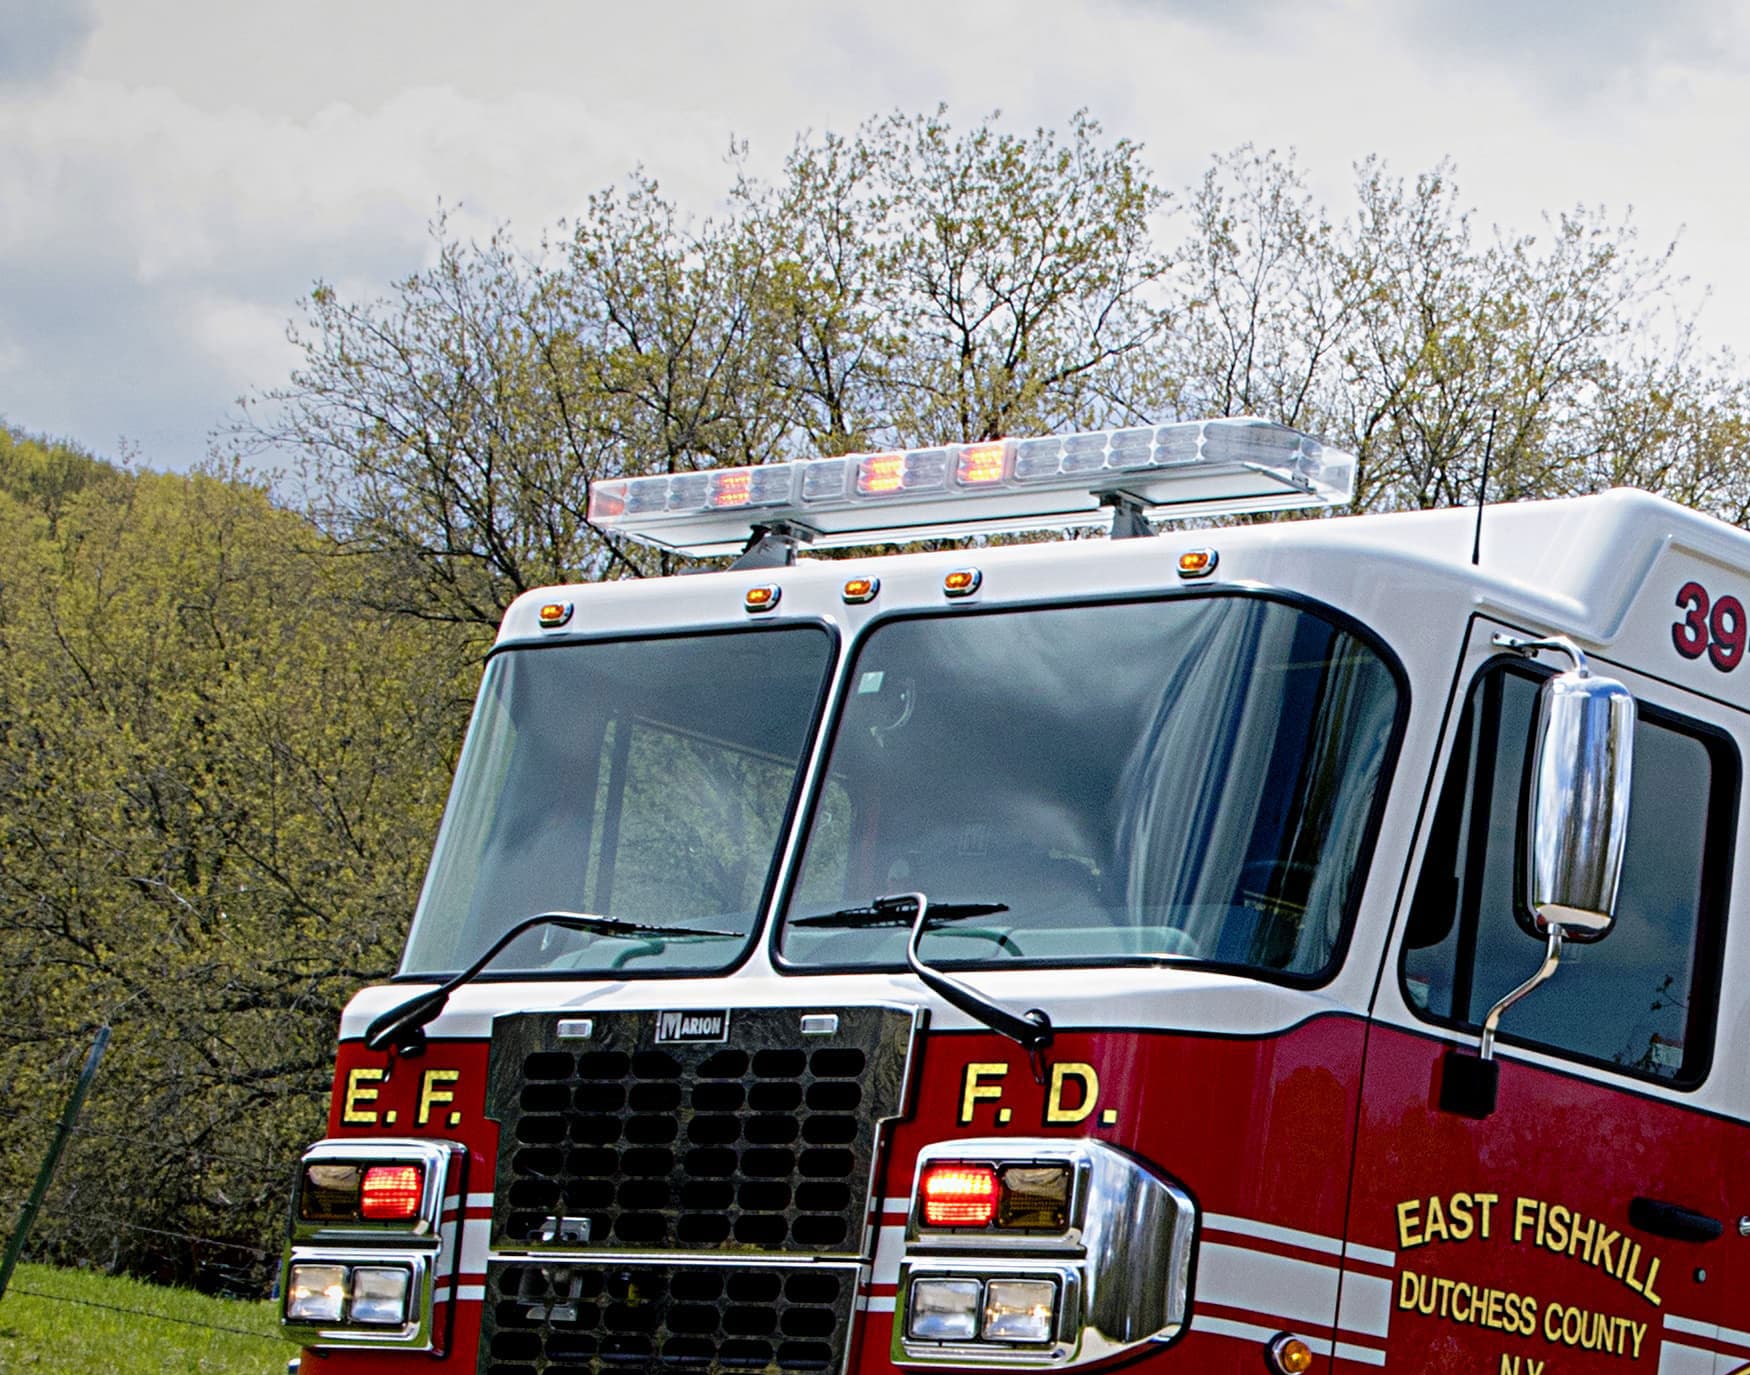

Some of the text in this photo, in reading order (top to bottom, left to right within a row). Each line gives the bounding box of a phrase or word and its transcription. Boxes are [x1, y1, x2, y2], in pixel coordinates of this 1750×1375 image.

[661, 1012, 721, 1039] MARION
[1397, 1193, 1661, 1306] EAST FISHKILL
[1399, 1271, 1648, 1359] DUTCHESS COUNTY
